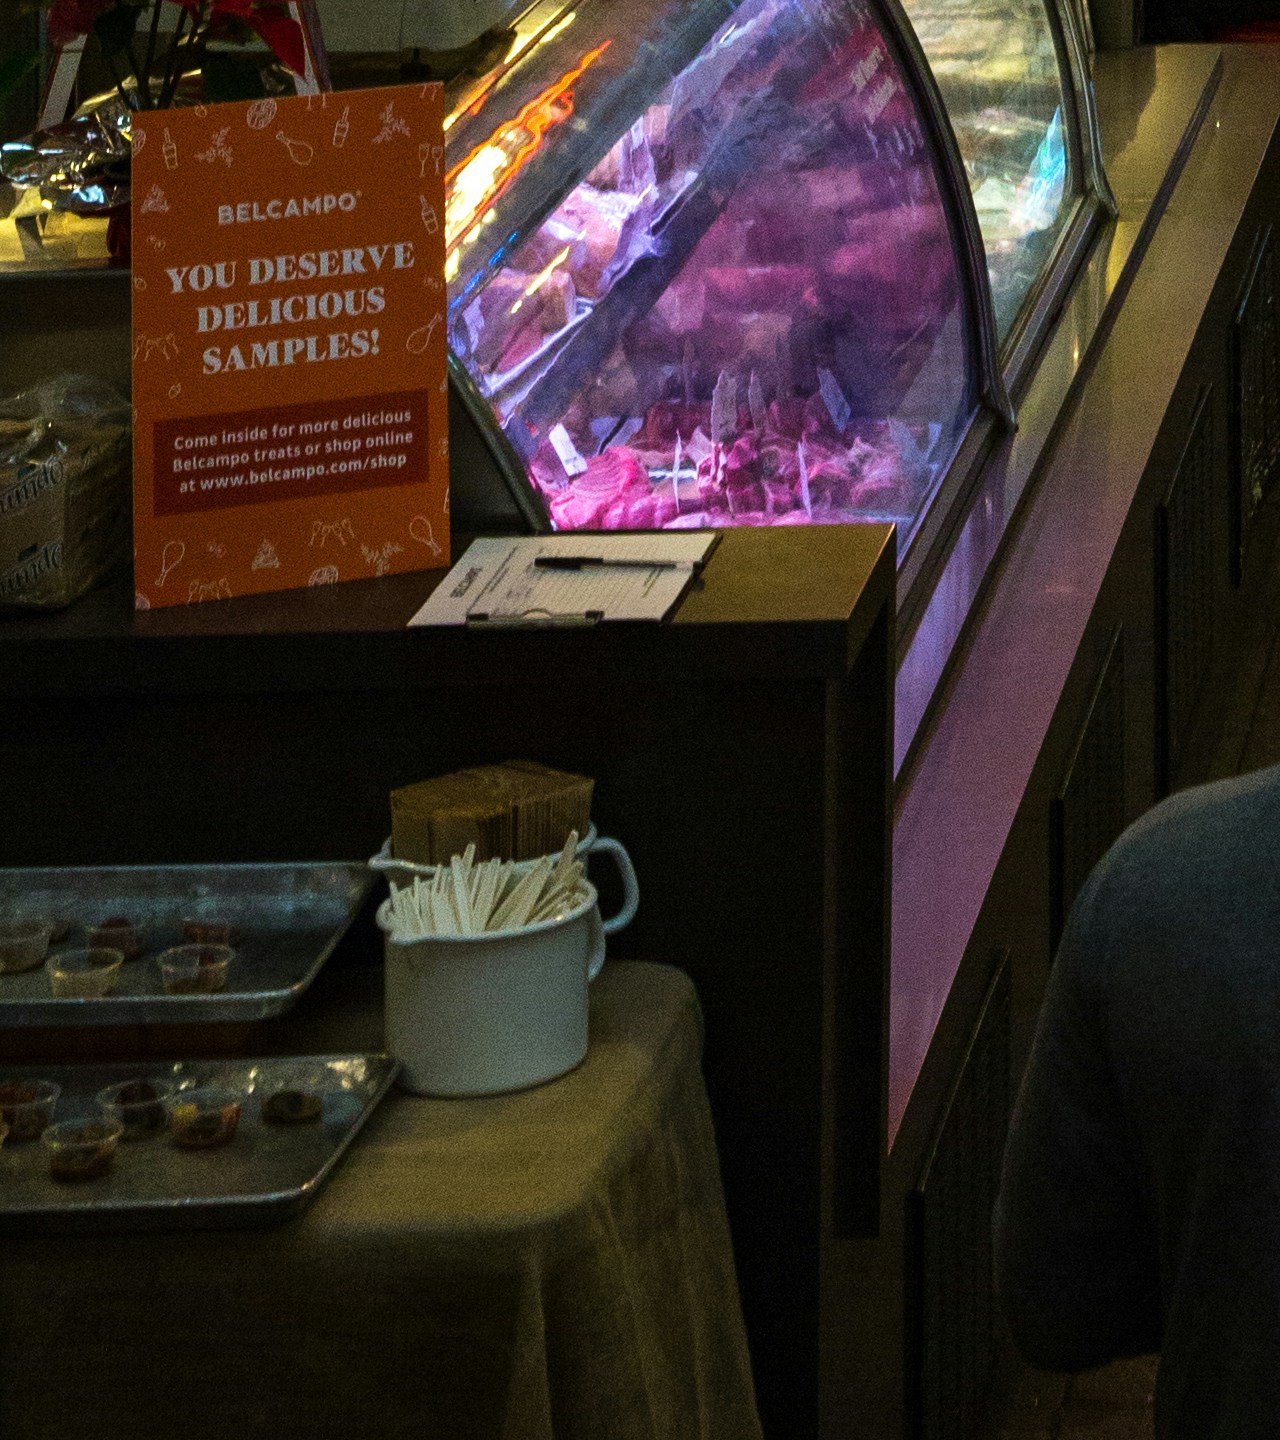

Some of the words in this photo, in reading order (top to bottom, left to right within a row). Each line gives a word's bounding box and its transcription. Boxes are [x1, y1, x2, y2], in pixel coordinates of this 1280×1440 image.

[217, 191, 358, 226] BELCAMPO
[164, 260, 238, 295] YOU
[248, 240, 416, 286] DESERVE
[195, 286, 387, 335] DELICIOUS
[201, 328, 381, 376] SAMPLES!
[174, 434, 219, 451] Come
[221, 425, 268, 445] inside
[271, 421, 296, 439] for
[299, 417, 339, 434] more
[342, 408, 412, 430] delicious
[172, 451, 250, 474] Belcampo
[253, 444, 301, 463] treats
[304, 442, 320, 457] or
[325, 437, 361, 456] shop
[365, 430, 414, 449] online
[179, 476, 196, 494] at
[200, 452, 407, 493] www.belcampo.com/shop
